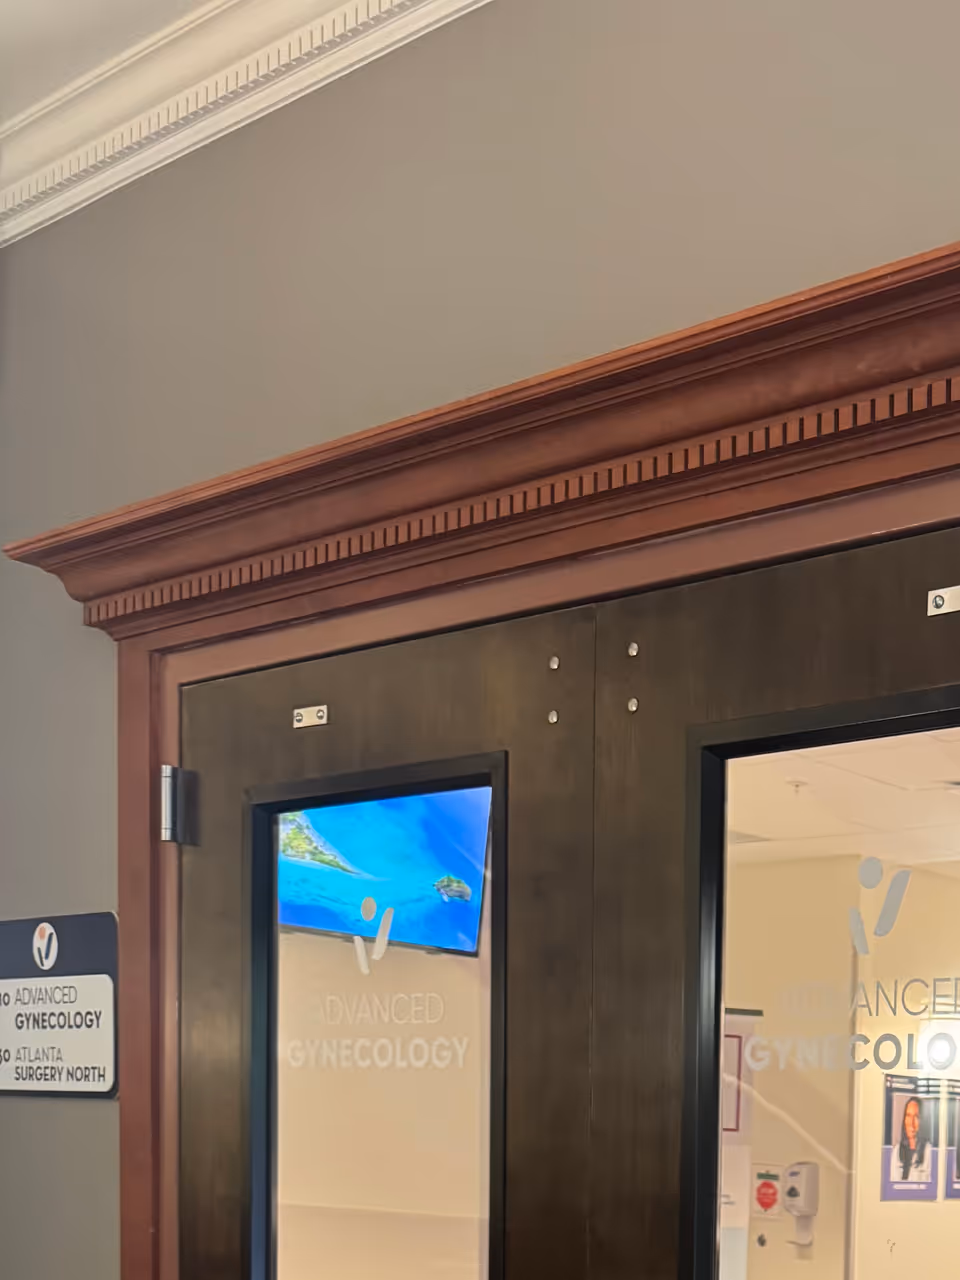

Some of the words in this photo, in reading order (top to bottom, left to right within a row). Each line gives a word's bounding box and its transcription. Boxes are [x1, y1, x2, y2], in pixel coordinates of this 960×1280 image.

[14, 985, 78, 1005] ADVANCED
[15, 1010, 102, 1030] GYNECOLOGY
[14, 1046, 63, 1064] ATLANTA
[287, 1036, 470, 1069] GYNECOLOGY
[14, 1065, 63, 1082] SURGERY
[67, 1065, 106, 1082] NORTH
